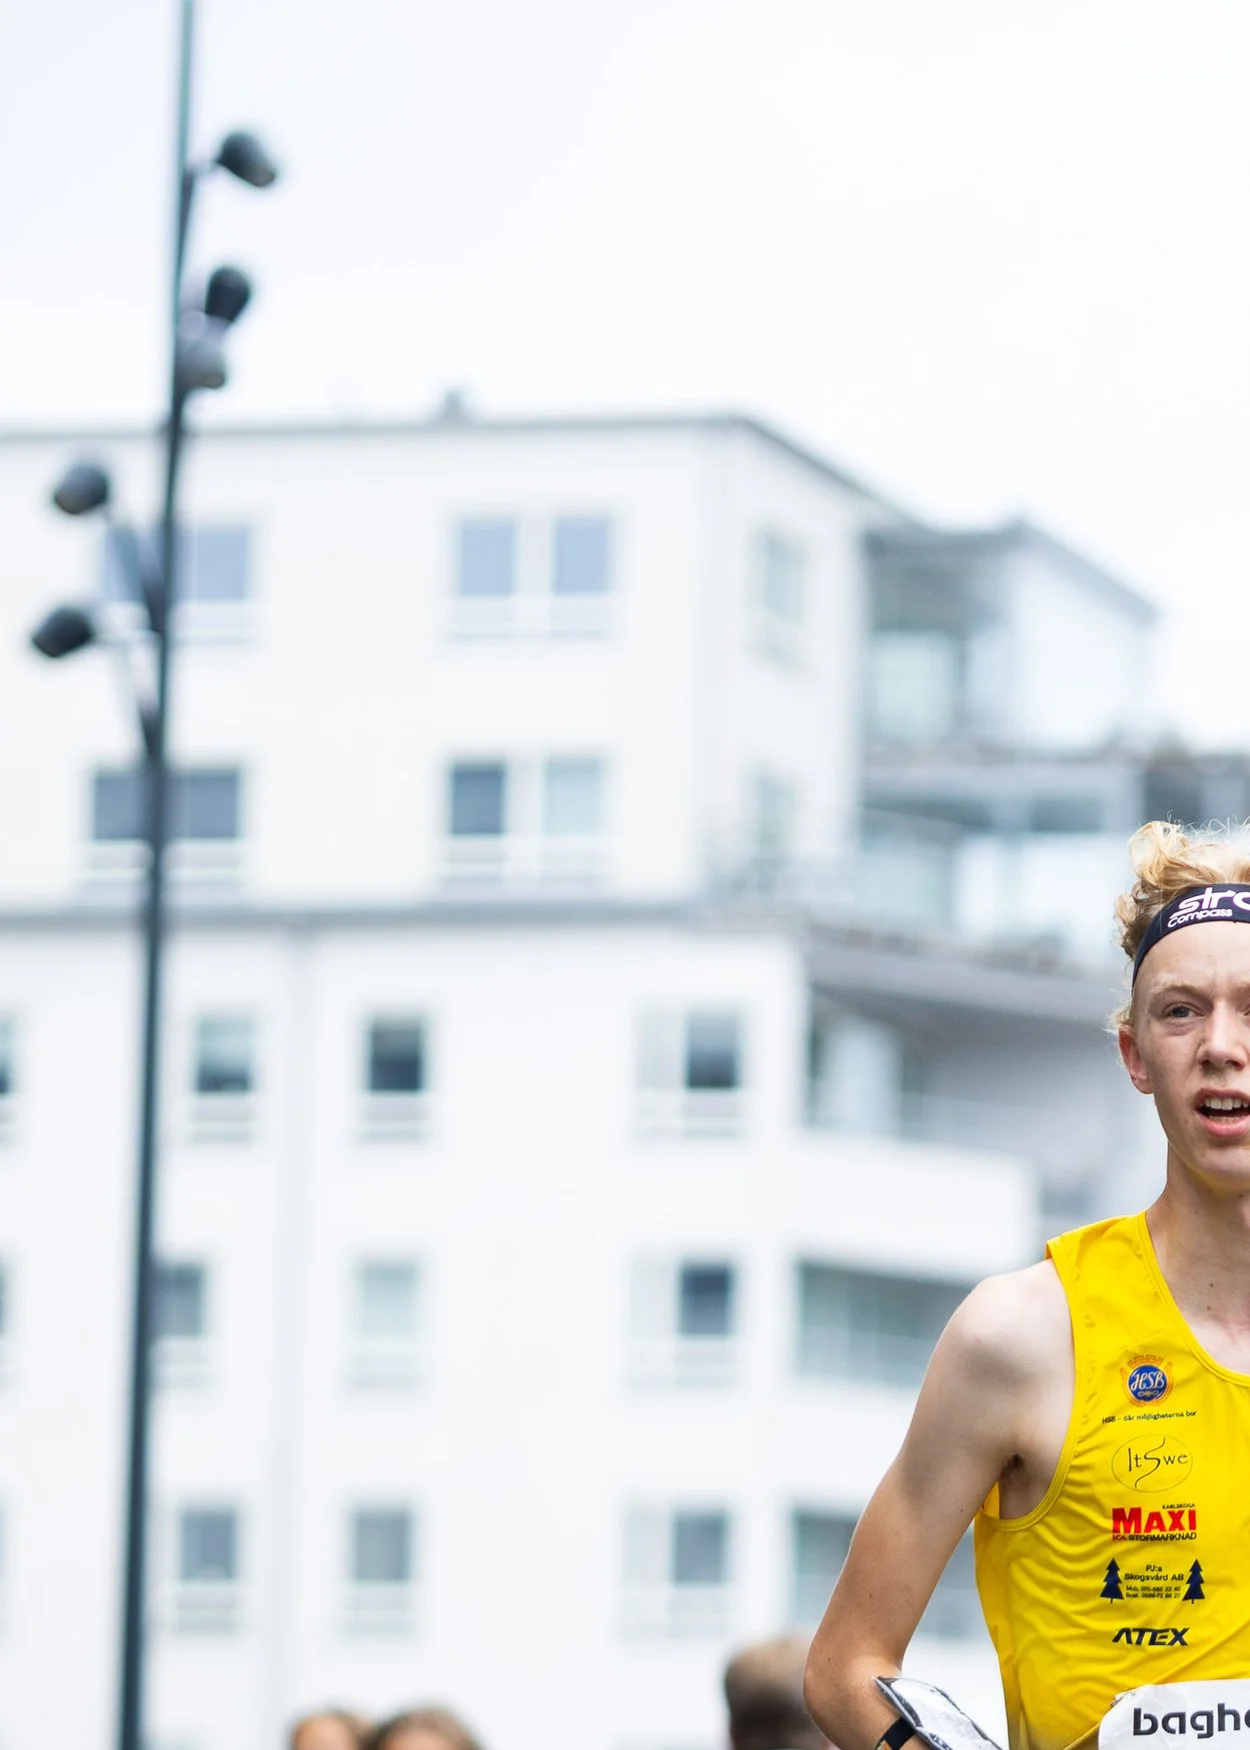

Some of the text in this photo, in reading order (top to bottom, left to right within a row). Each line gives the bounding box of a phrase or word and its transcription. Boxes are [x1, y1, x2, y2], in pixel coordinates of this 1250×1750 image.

[1167, 908, 1233, 928] compass
[1131, 1371, 1165, 1391] HSB
[1112, 1507, 1197, 1533] MAXI
[1128, 1532, 1197, 1541] STORMARKNAD
[1124, 1572, 1184, 1583] Skogsvård AB
[1146, 1564, 1163, 1573] PJ:s
[1112, 1627, 1190, 1647] ATEX
